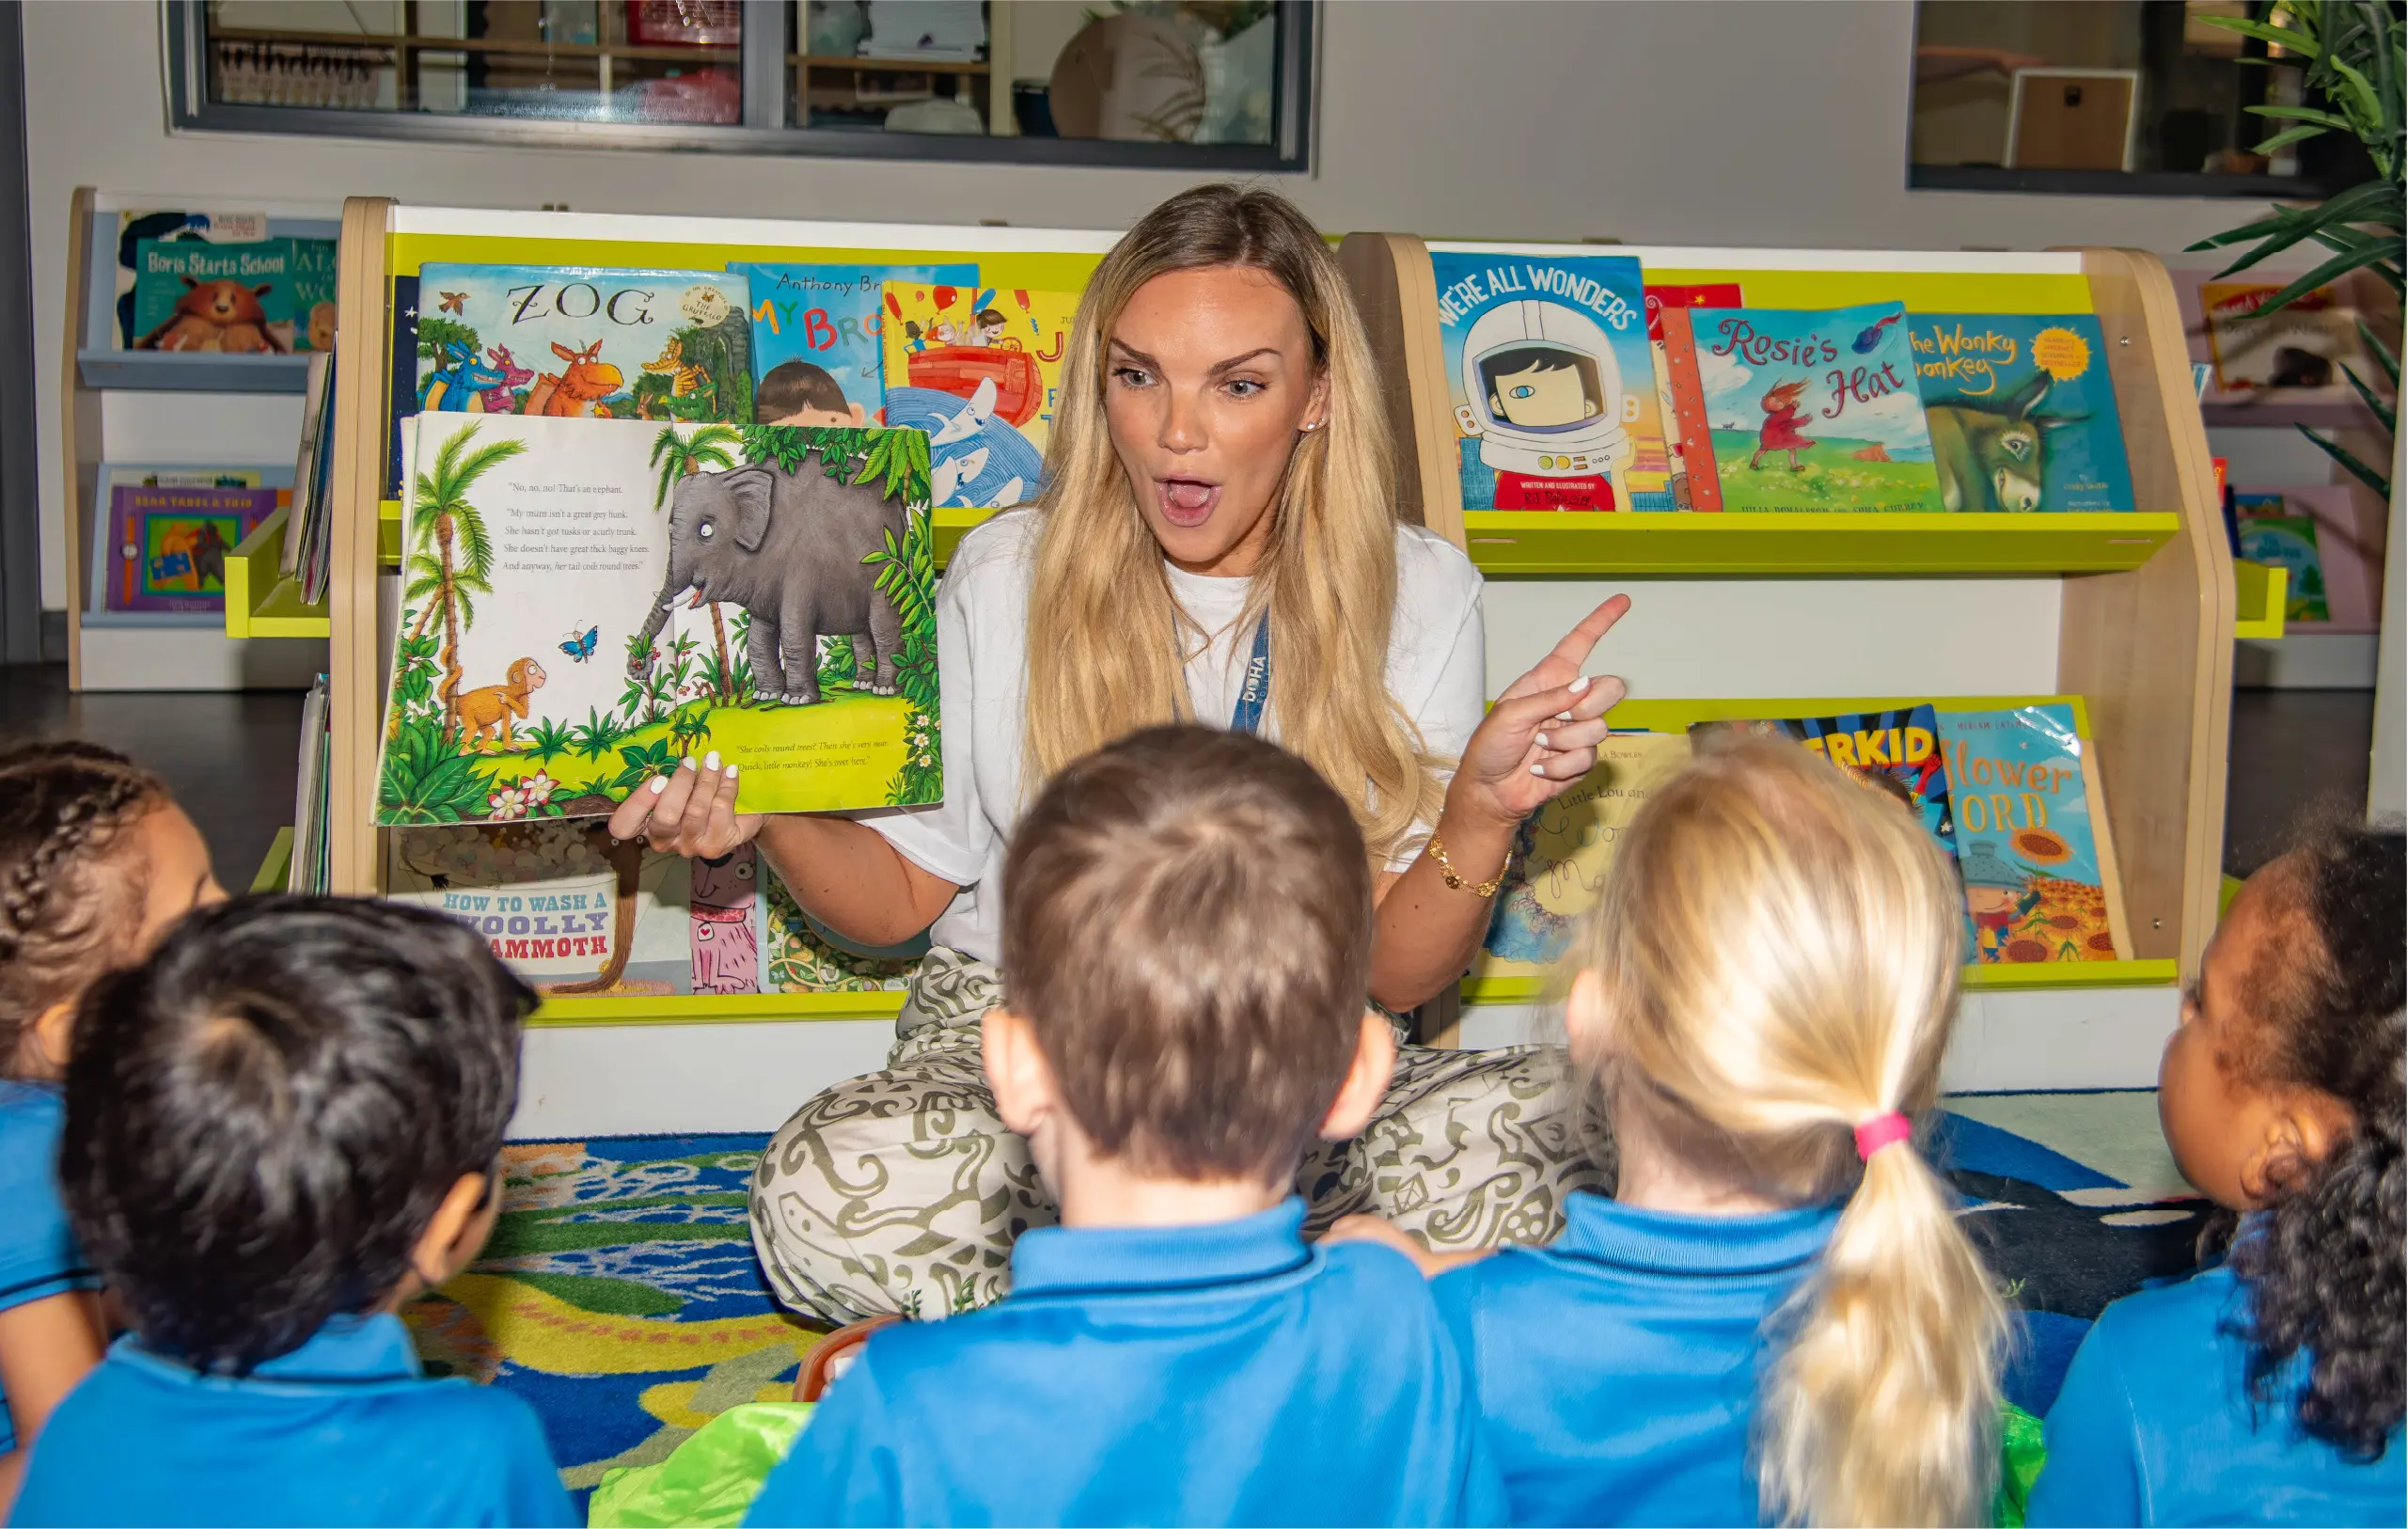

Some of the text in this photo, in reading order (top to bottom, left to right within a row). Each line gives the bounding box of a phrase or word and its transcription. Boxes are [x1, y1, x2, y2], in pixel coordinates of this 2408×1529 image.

[220, 44, 370, 86] irthdays
[148, 252, 185, 274] Boris
[188, 252, 236, 276] Starts
[240, 252, 285, 276] School
[777, 273, 853, 297] Anthony
[506, 282, 655, 326] ZOG
[696, 300, 712, 311] THE
[1439, 264, 1637, 331] WE'RE ALL WONDERS
[752, 298, 798, 335] MY
[1711, 318, 1838, 368] Rosie's
[1909, 323, 2019, 366] he Wonky
[1822, 361, 1904, 419] Hat
[558, 482, 581, 494] That's
[1520, 481, 1543, 490] WRITTEN
[1544, 481, 1555, 490] AND
[549, 509, 565, 518] isn't
[573, 511, 592, 520] great
[505, 527, 519, 536] She
[521, 527, 544, 536] hasn't
[546, 528, 559, 538] got
[561, 527, 581, 536] tusks
[504, 544, 519, 553] She
[520, 544, 548, 553] doesn't
[551, 544, 568, 553] have
[570, 545, 590, 555] great
[608, 544, 628, 555] baggy
[630, 545, 650, 554] knees.
[503, 561, 520, 571] And
[522, 563, 553, 573] anyway,
[554, 562, 568, 571] her
[568, 562, 581, 571] tail
[1242, 656, 1267, 702] DOHA
[753, 744, 770, 753] coils
[772, 743, 795, 752] round
[819, 741, 838, 750] Then
[839, 741, 856, 750] she's
[857, 741, 872, 752] very
[1610, 750, 1643, 760] BOWLES
[738, 762, 763, 772] Quick,
[763, 760, 780, 769] little
[814, 758, 832, 768] She's
[1557, 787, 1595, 811] Little
[1597, 785, 1624, 798] Lou
[1948, 793, 2048, 833] ORD
[443, 892, 607, 912] HOW TO WASH A
[489, 936, 608, 959] AMMOTH
